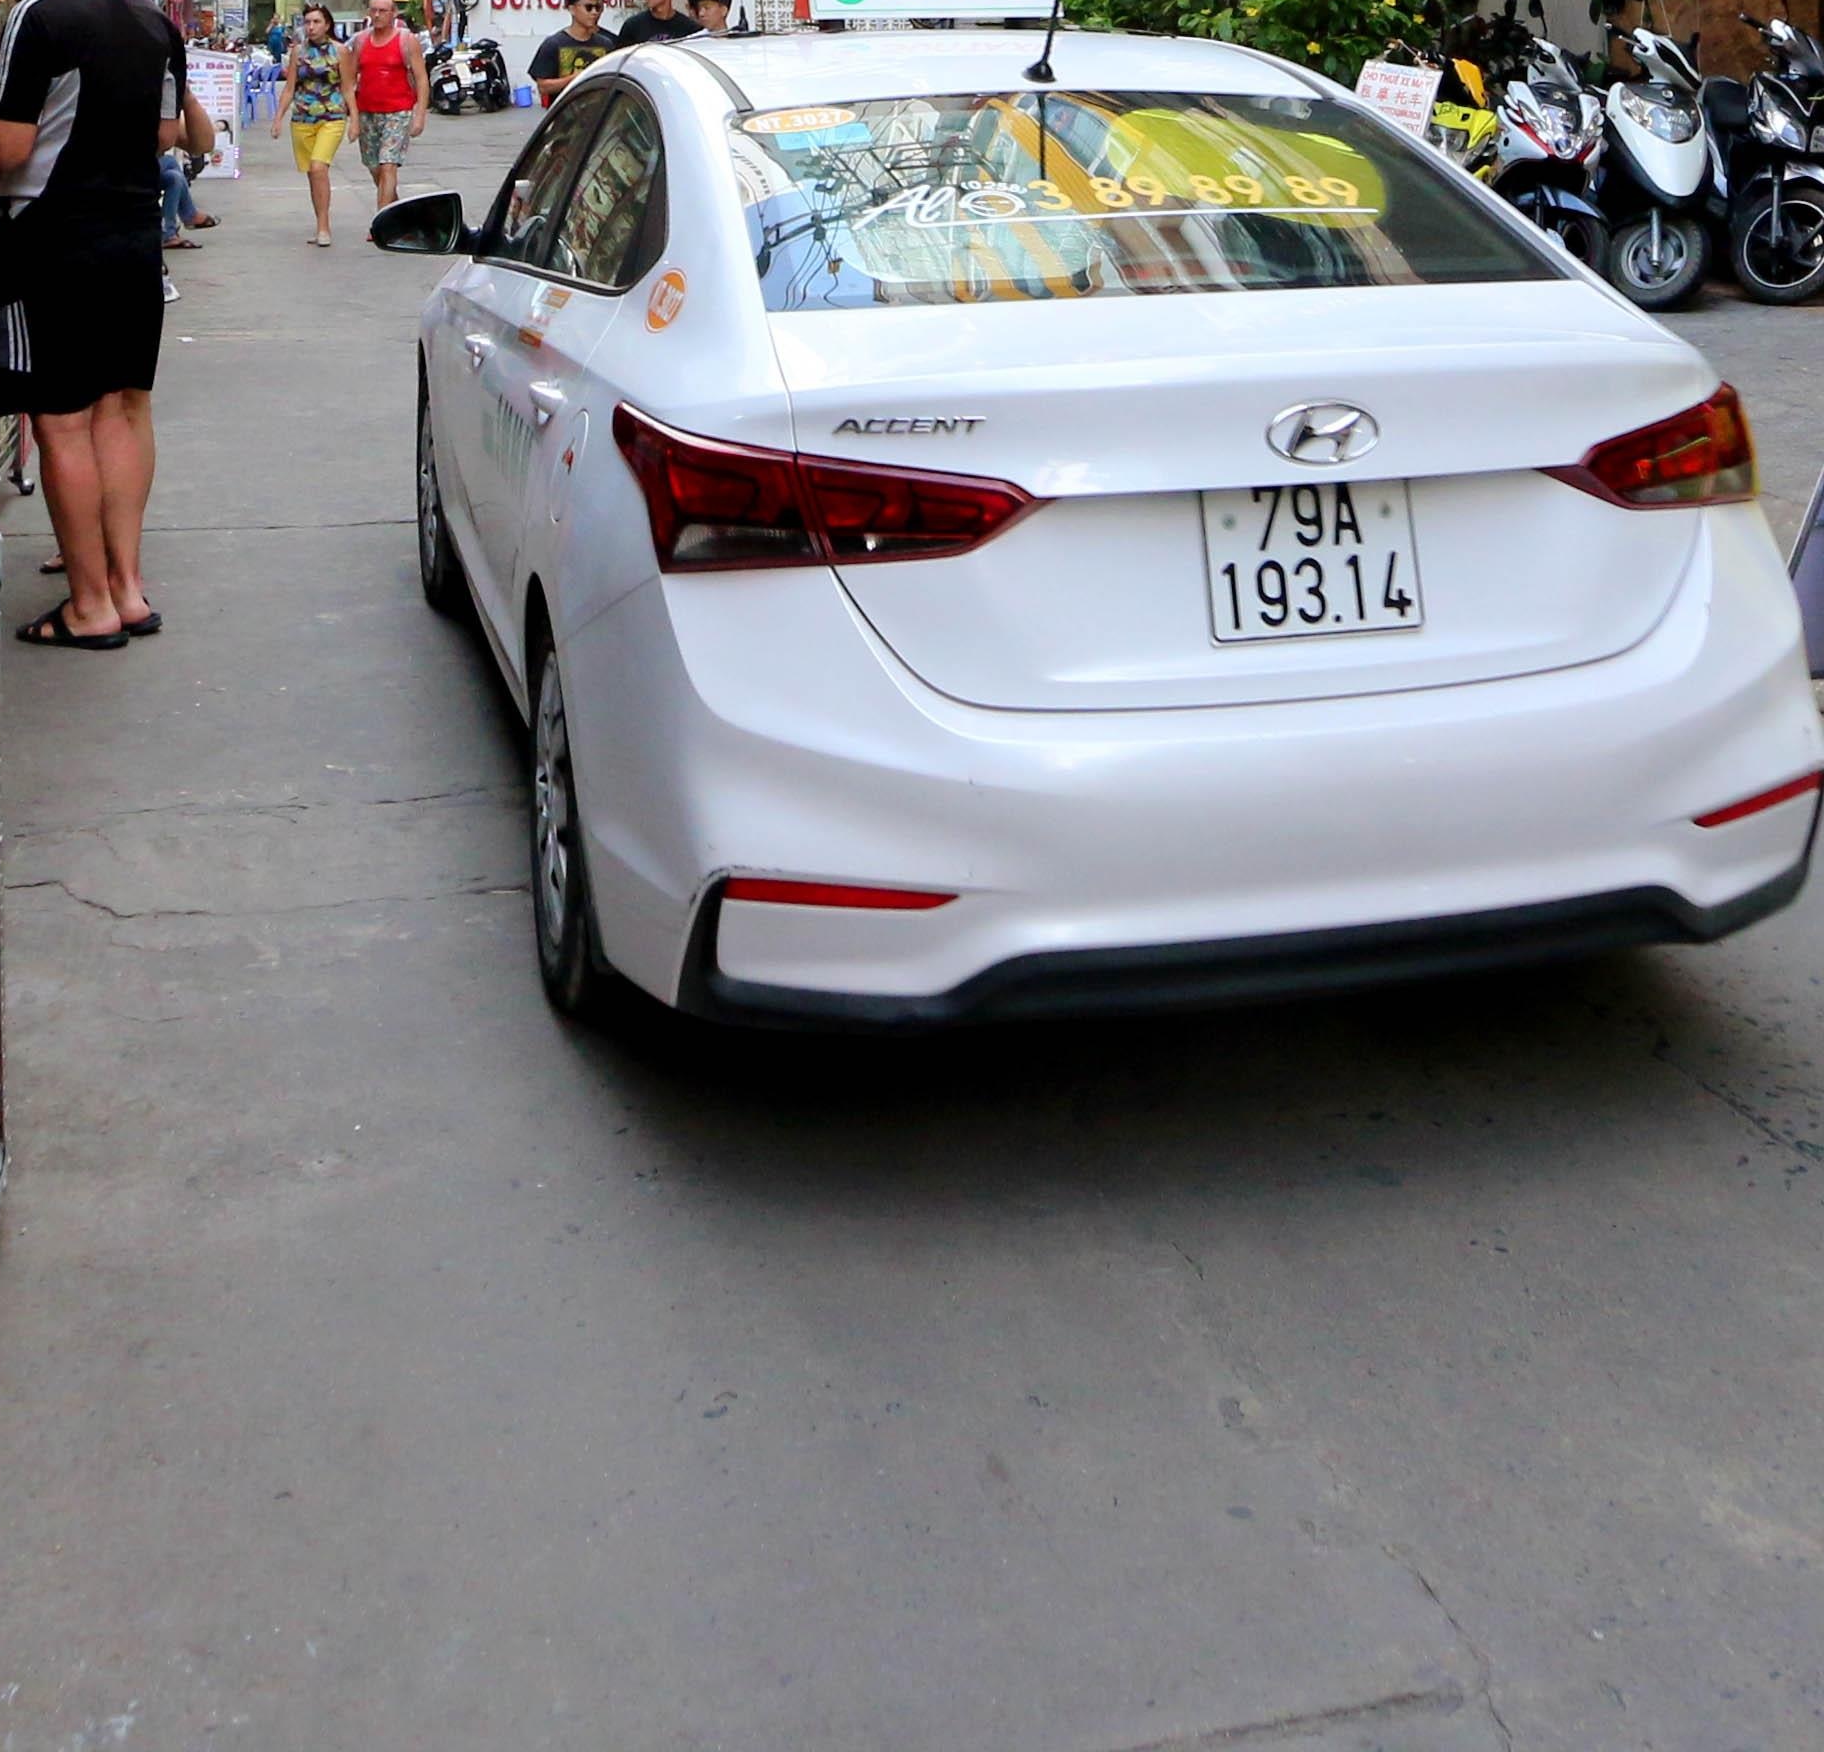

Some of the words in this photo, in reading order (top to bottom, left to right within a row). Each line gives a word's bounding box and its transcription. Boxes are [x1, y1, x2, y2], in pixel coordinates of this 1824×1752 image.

[1090, 176, 1166, 207] 89
[1190, 174, 1263, 205] 89
[1285, 175, 1360, 206] 89
[832, 416, 986, 436] ACCENT
[1252, 482, 1363, 551] 79A
[1223, 551, 1412, 631] 193.14
